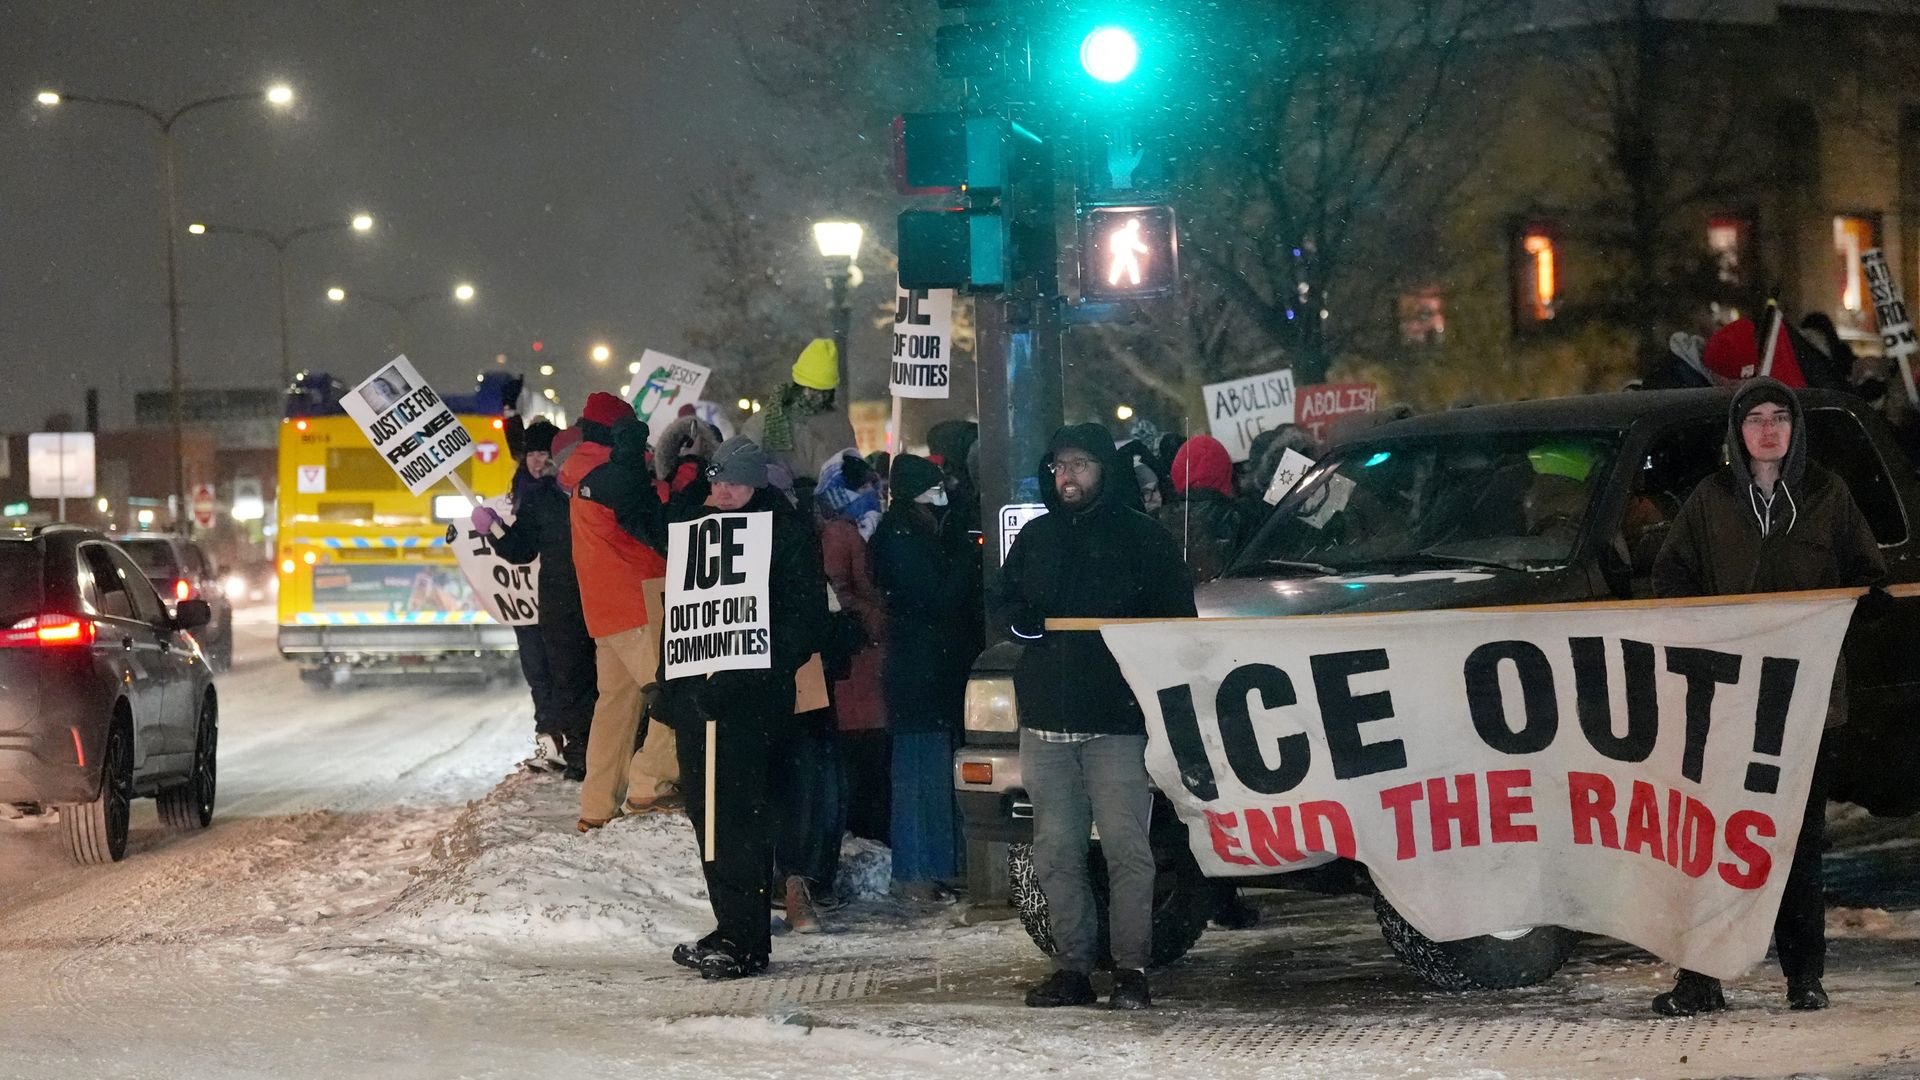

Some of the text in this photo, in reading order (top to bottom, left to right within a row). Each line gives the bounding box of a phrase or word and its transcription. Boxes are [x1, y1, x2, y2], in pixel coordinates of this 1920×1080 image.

[908, 334, 941, 359] OUR
[669, 363, 701, 386] RESIST
[369, 385, 440, 446] JUSTICE FOR
[1215, 376, 1292, 420] ABOLISH
[1302, 387, 1377, 421] ABOLISH
[386, 410, 456, 465] RENEE
[399, 425, 472, 487] NICOLE GOOD
[683, 516, 748, 591] ICE
[492, 564, 534, 591] OUT
[670, 595, 758, 633] OUT OF OUR
[666, 627, 769, 666] COMMUNITIES
[1156, 635, 1800, 802] ICE OUT!
[1204, 768, 1777, 891] END THE RAIDS
